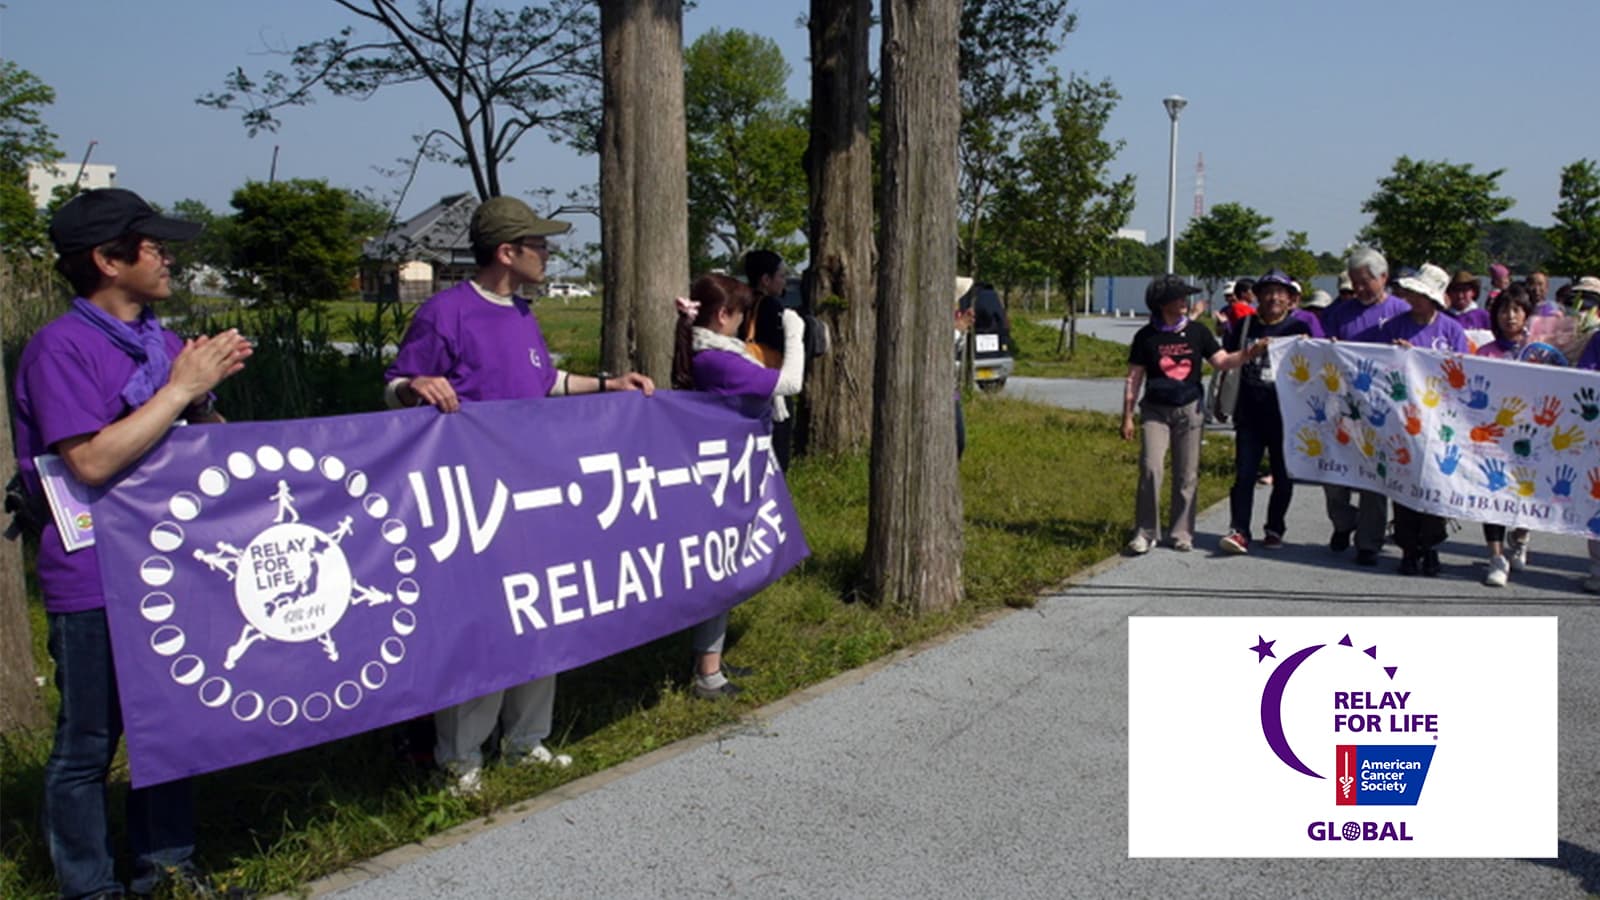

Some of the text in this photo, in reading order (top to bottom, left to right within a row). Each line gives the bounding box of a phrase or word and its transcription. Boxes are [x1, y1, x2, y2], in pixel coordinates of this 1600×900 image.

[250, 537, 306, 560] RELAY
[253, 556, 289, 574] FOR
[502, 499, 786, 636] RELAY FOR LIFE
[256, 570, 296, 590] LIFE
